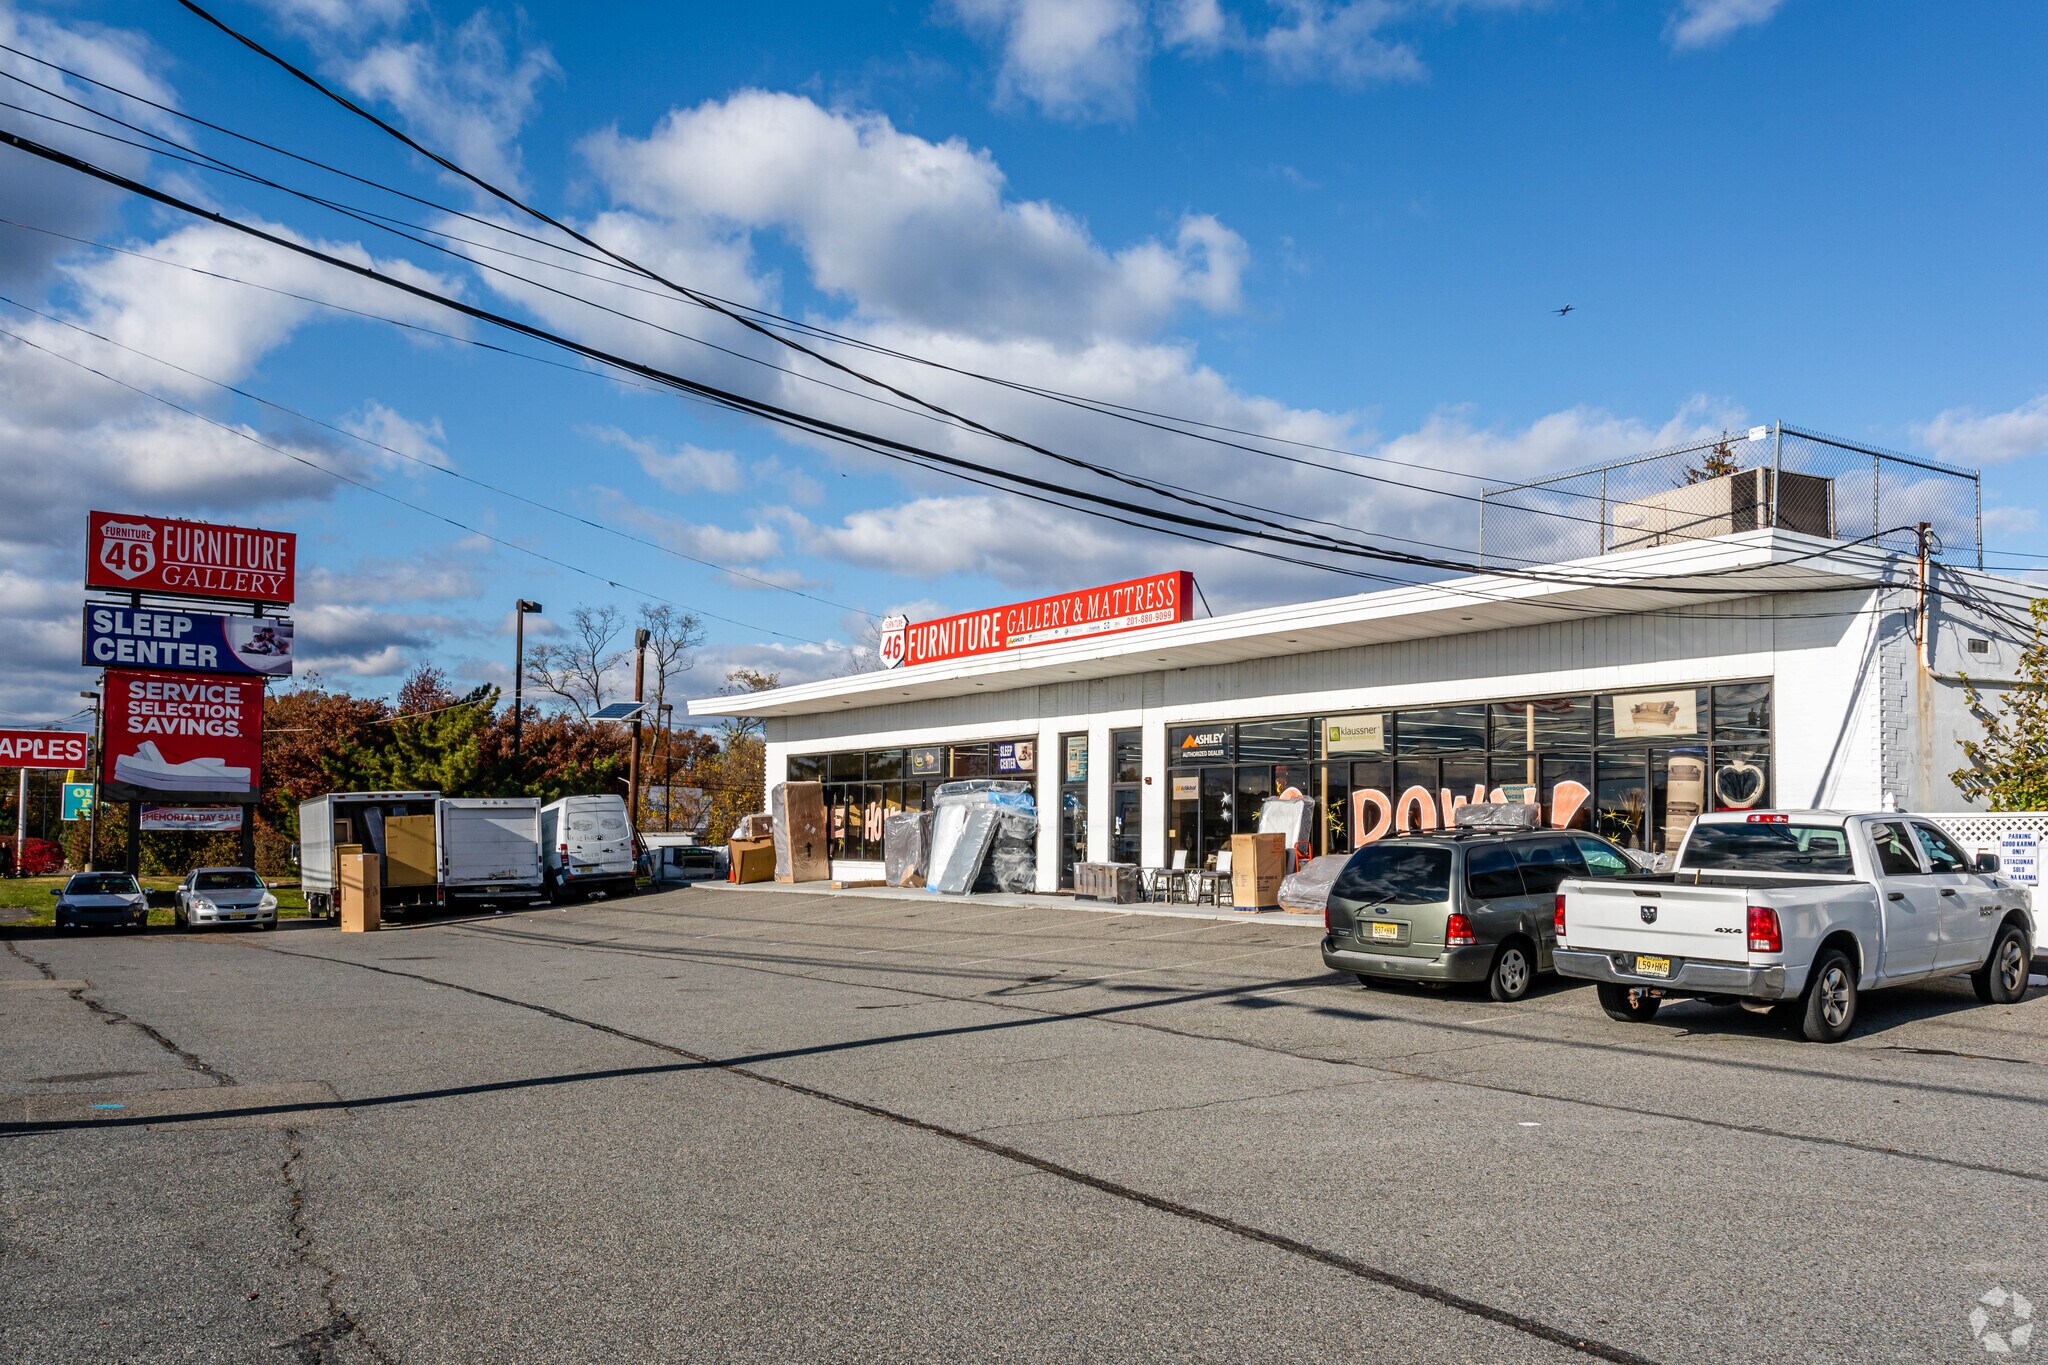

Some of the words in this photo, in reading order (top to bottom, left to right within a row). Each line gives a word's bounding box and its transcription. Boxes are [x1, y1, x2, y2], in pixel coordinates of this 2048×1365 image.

[105, 525, 151, 540] FURNITURE
[104, 542, 148, 572] 46
[163, 525, 287, 571] FURNITURE
[162, 565, 286, 594] GALLERY
[1006, 599, 1071, 634] GALLERY
[1073, 597, 1083, 622] &
[1087, 578, 1175, 620] MATTRESS
[93, 609, 193, 638] SLEEP
[1127, 611, 1172, 626] 201-880-9099
[883, 635, 901, 659] 46
[908, 612, 1001, 661] FURNITURE
[93, 637, 218, 668] CENTER
[128, 681, 244, 704] SERVICE.
[127, 701, 243, 720] SELECTION.
[127, 716, 243, 737] SAVINGS.
[1341, 726, 1377, 735] klaussner
[1194, 733, 1224, 744] ASHLEY
[1000, 745, 1013, 757] SLEEP
[1000, 758, 1016, 770] CENTER
[146, 813, 197, 821] MEMORIAL
[199, 813, 216, 821] DAY
[218, 813, 240, 821] SALE
